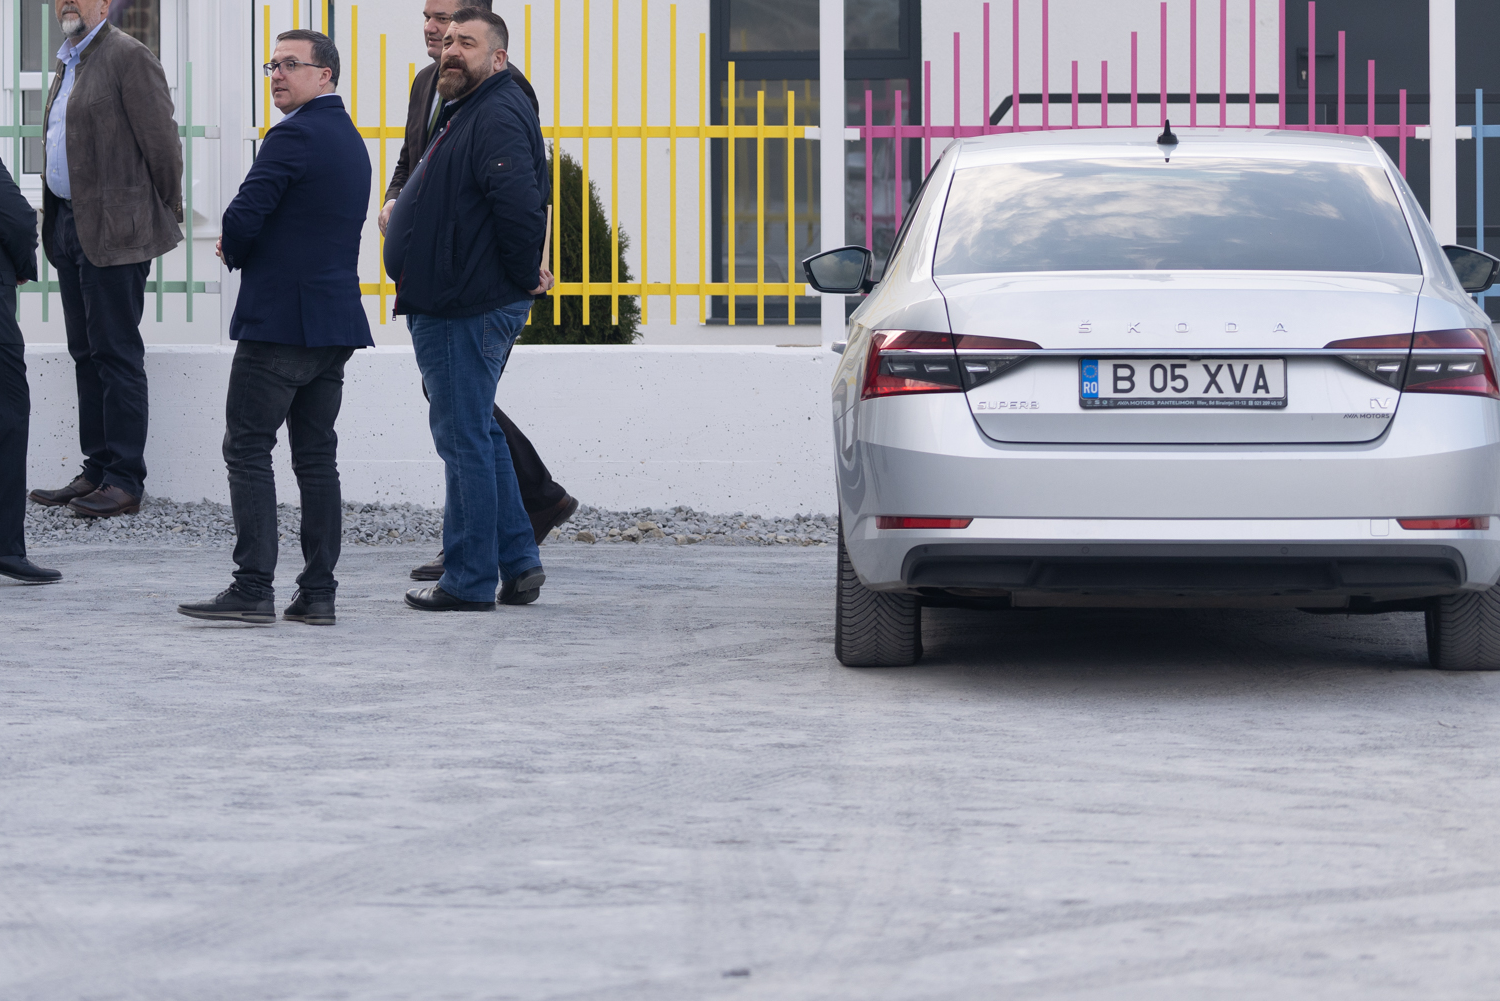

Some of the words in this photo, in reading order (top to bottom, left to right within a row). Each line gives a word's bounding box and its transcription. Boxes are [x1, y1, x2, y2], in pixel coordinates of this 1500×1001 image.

[1112, 363, 1136, 394] B
[1149, 363, 1189, 394] 05
[1202, 363, 1271, 394] XVA
[1083, 381, 1098, 394] RO
[977, 401, 1040, 410] SUPERB
